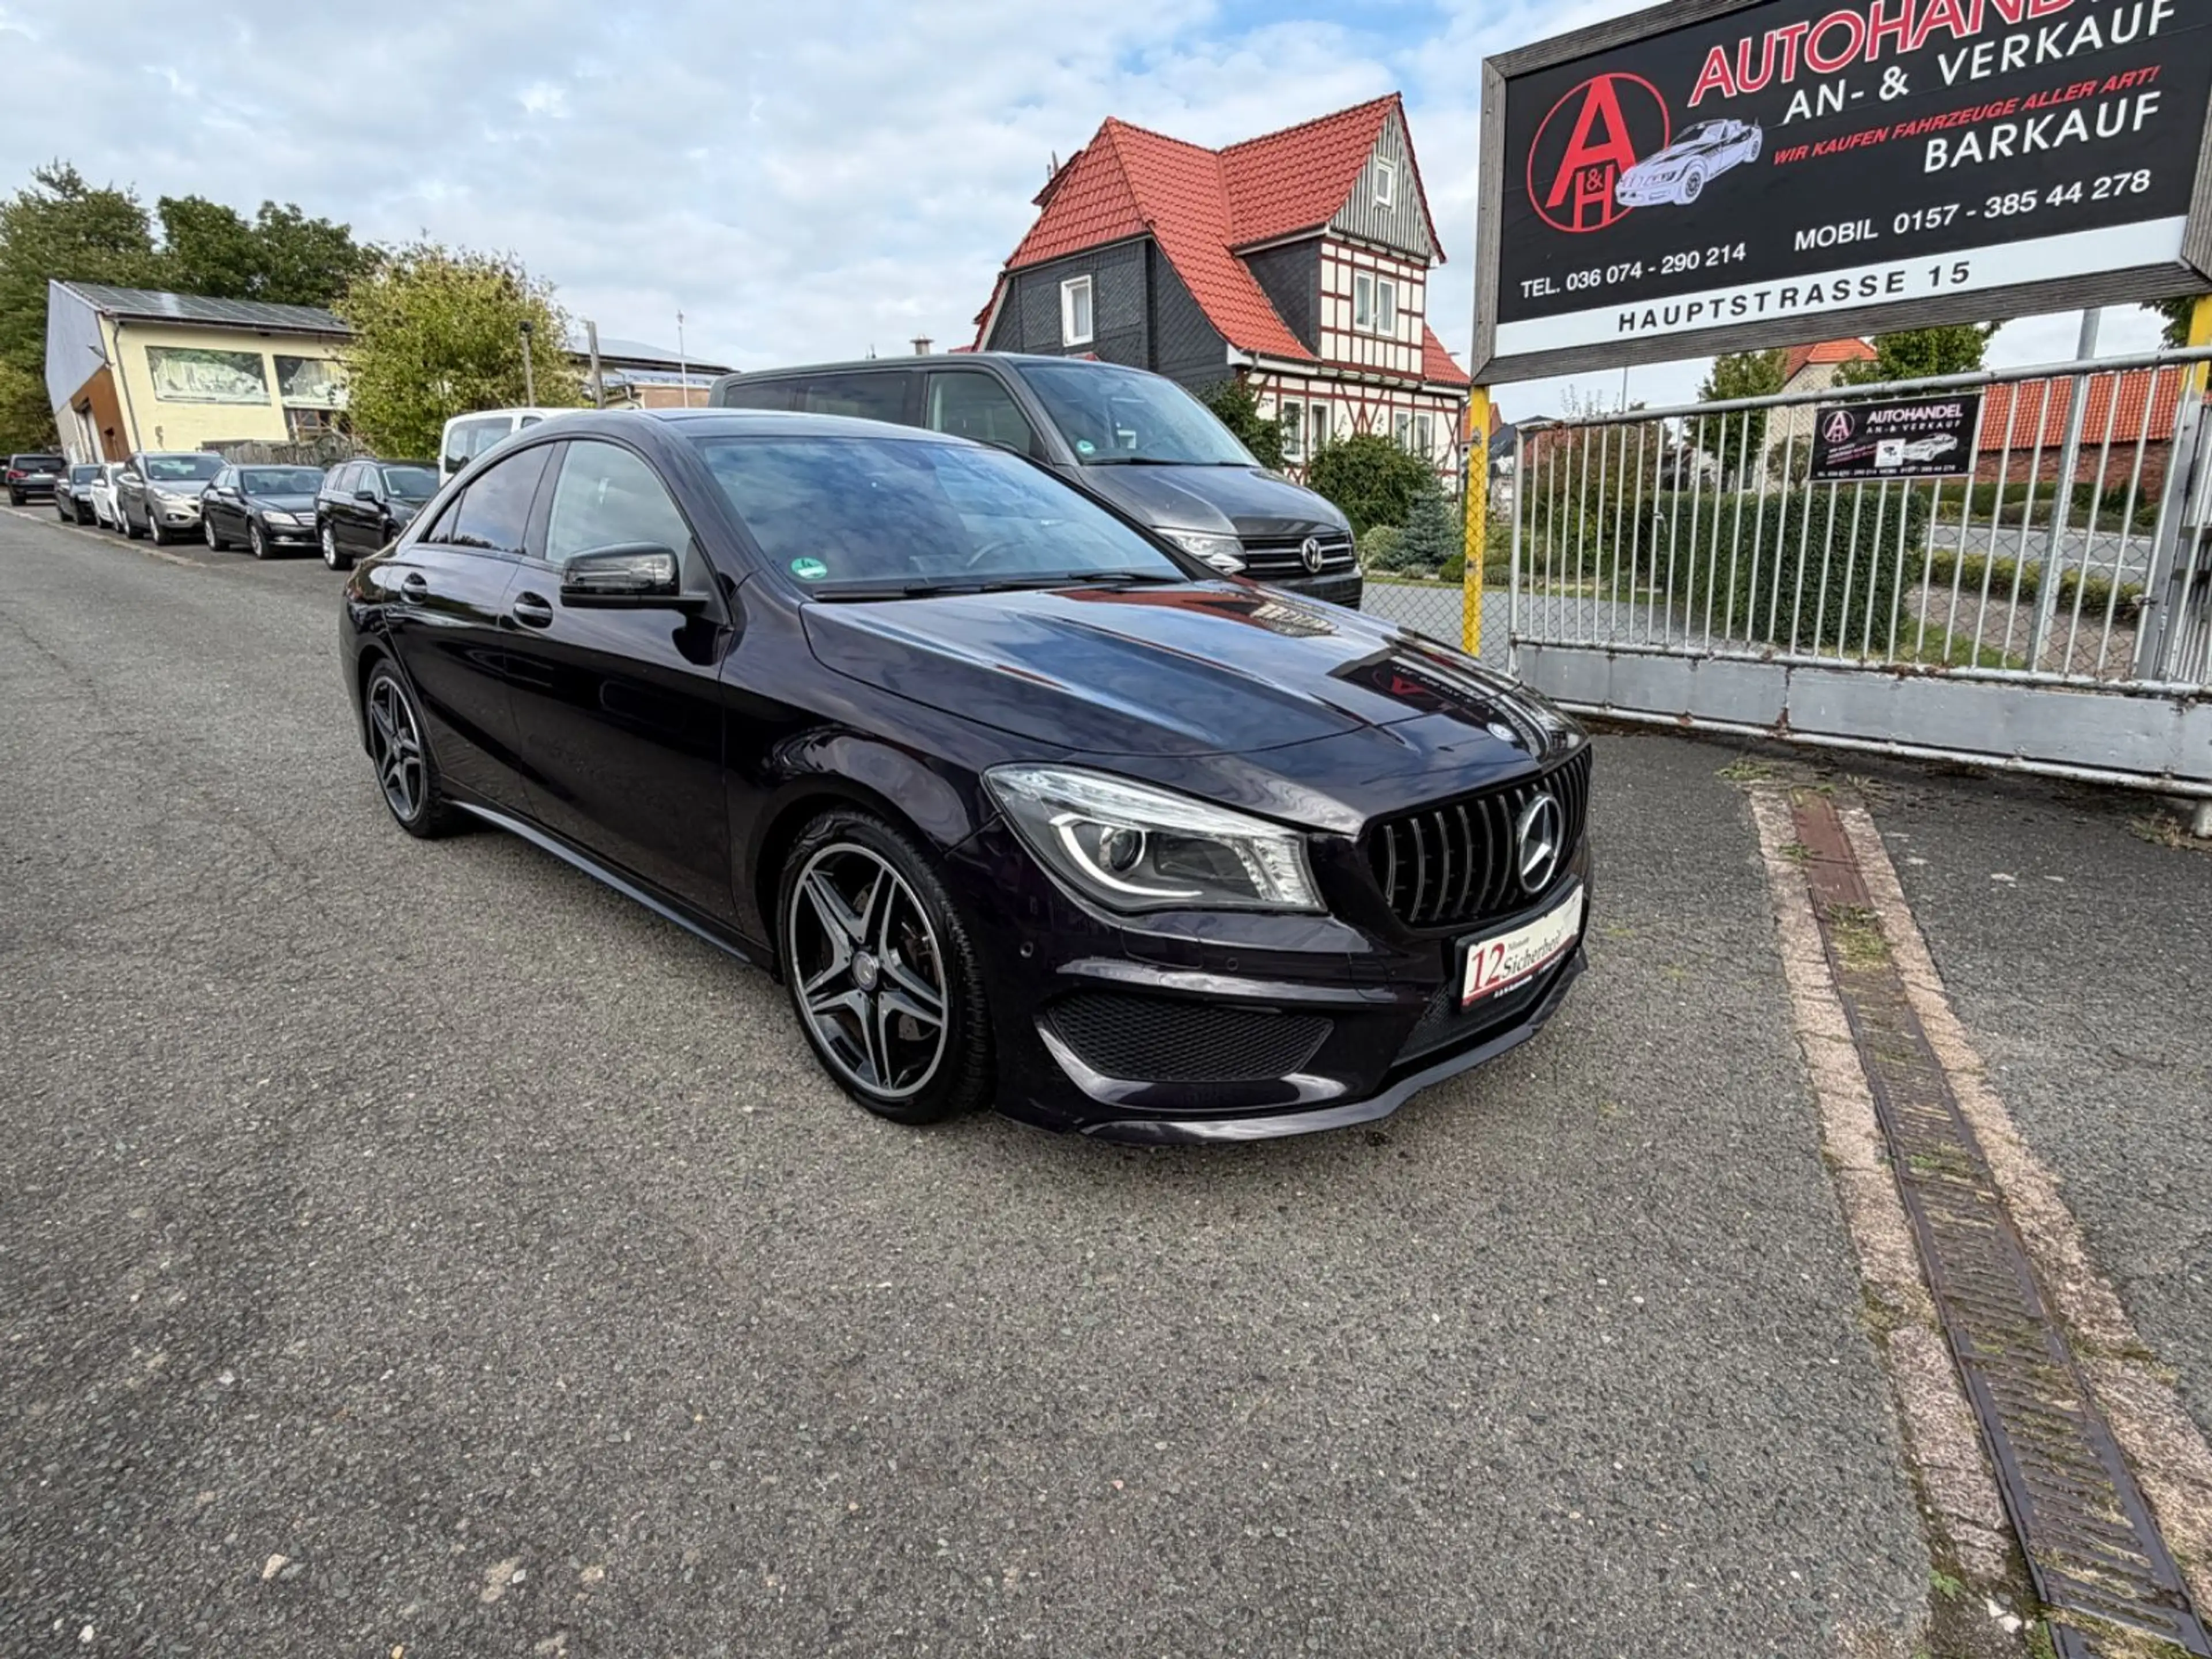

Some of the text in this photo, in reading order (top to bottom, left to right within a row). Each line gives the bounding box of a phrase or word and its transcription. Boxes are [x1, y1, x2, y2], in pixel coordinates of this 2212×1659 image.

[1782, 0, 2175, 125] AN- & VERKAUF
[1773, 65, 2161, 165] WIR KAUFEN FAHRZEUGE ALLER ART!
[1924, 90, 2161, 173] BARKAUF
[1794, 218, 1878, 251] MOBIL
[1893, 203, 1960, 234] 0157
[1984, 190, 2037, 218] 385
[2046, 181, 2082, 206] 44
[2091, 169, 2151, 200] 278
[1520, 277, 1560, 298] TEL.
[1566, 268, 1601, 291] 036
[1606, 261, 1642, 284] 074
[1661, 250, 1700, 274] 290
[1705, 243, 1746, 267] 214
[1618, 262, 1969, 332] HAUPTSTRASSE 15
[1866, 404, 1964, 425] AUTOHANDEL
[1903, 420, 1961, 431] VERKAUF
[1469, 942, 1505, 993] 12
